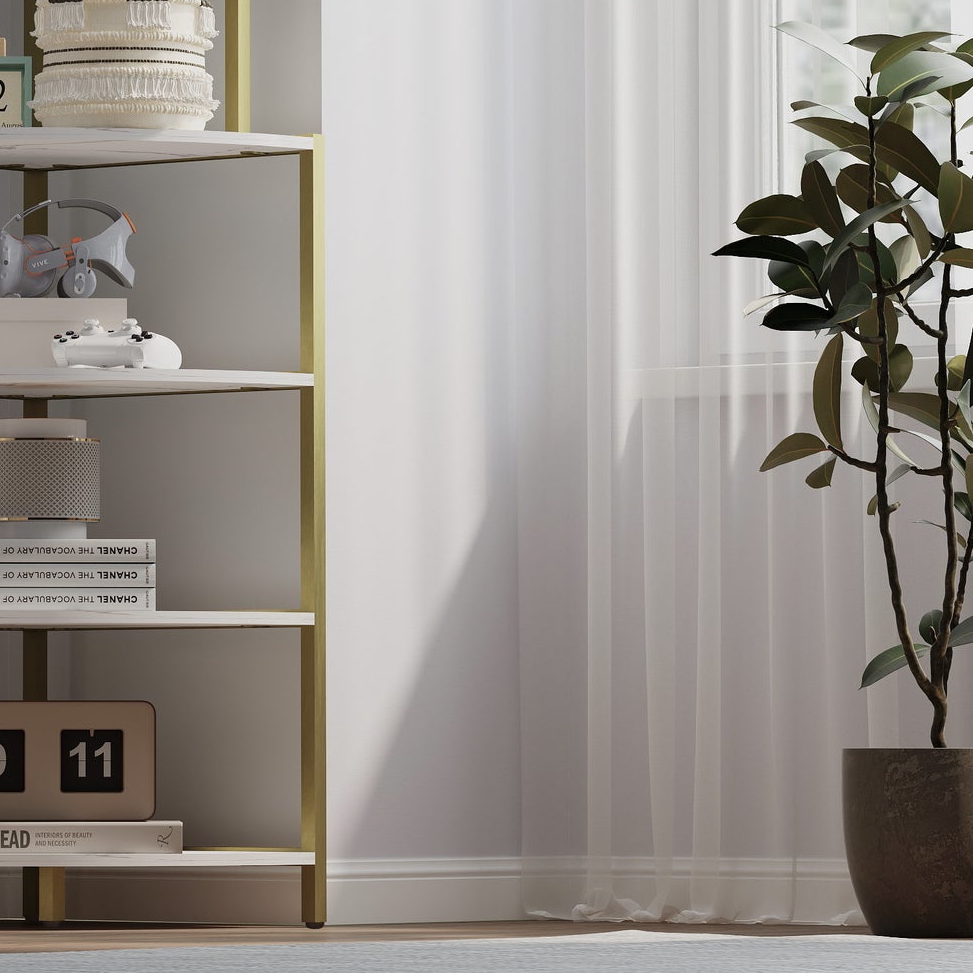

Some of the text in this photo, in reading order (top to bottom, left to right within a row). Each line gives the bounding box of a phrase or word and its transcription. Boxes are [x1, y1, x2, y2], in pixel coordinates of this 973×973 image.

[32, 258, 49, 268] VIVE
[3, 546, 15, 555] OF
[17, 546, 76, 555] VOCABULARY
[78, 546, 95, 555] THE
[97, 546, 138, 555] CHANEL
[3, 571, 15, 580] OF
[17, 571, 76, 580] VOCABULARY
[78, 571, 95, 580] THE
[97, 571, 138, 580] CHANEL
[3, 595, 15, 604] OF
[17, 595, 76, 604] VOCABULARY
[78, 595, 95, 604] THE
[97, 595, 138, 604] CHANEL
[69, 742, 111, 777] 11
